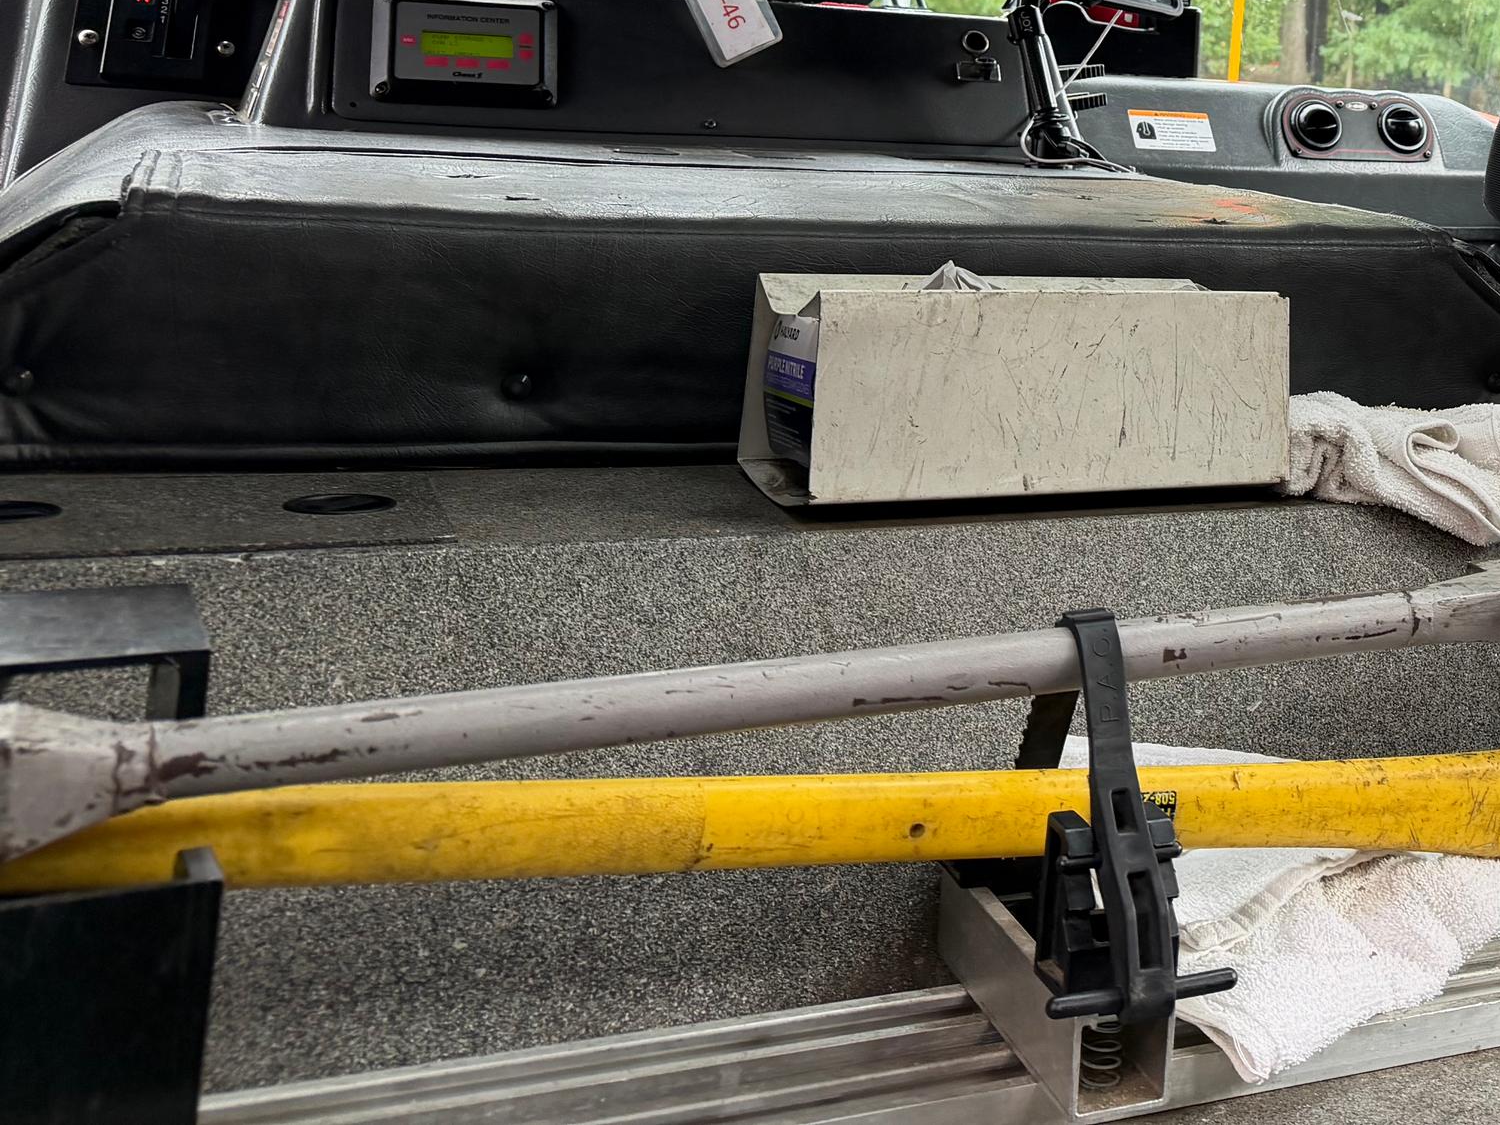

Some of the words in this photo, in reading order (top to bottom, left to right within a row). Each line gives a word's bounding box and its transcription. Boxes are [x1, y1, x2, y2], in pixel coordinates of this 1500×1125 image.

[427, 13, 479, 23] INFORMATION
[479, 16, 511, 24] CENTER
[767, 354, 786, 374] PURPLE
[785, 360, 805, 380] NITRILE
